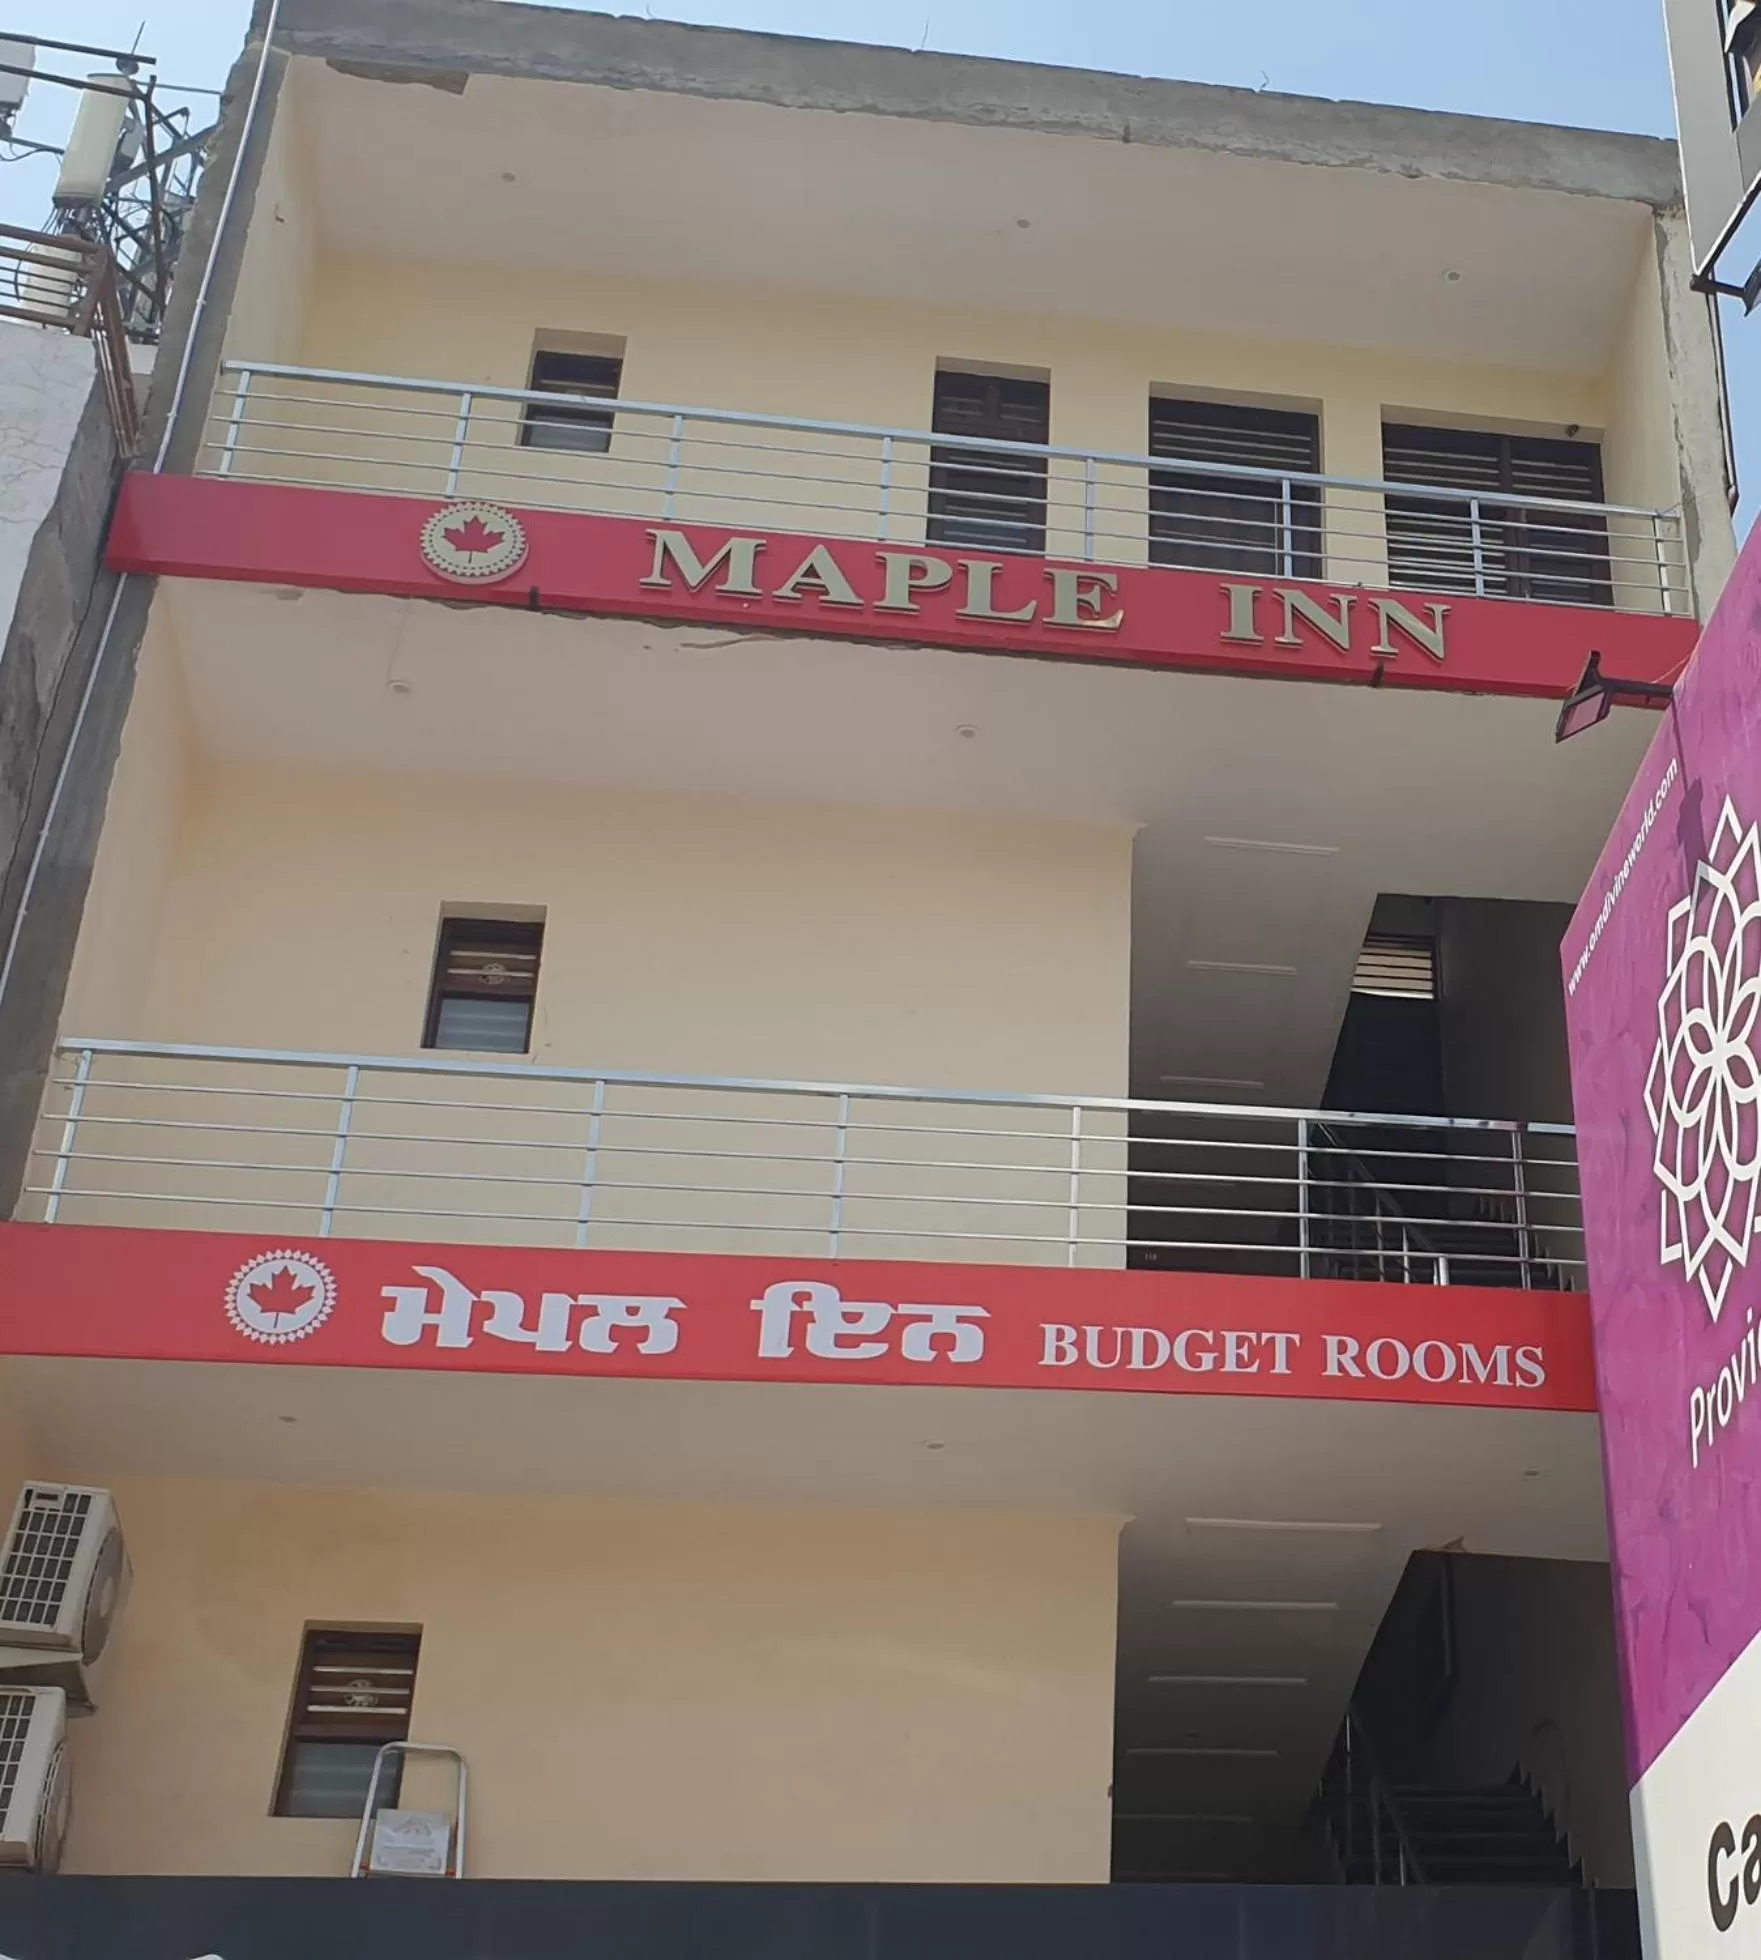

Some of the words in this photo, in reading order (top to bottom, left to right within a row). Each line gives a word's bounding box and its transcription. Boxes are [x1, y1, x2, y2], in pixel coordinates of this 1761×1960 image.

[639, 527, 1125, 633] MAPLE
[1219, 582, 1452, 663] INN
[1567, 758, 1679, 997] www.omdivineworld.com
[380, 1265, 688, 1355] ਮੇਪਲ
[750, 1280, 992, 1363] ਇਨ
[1039, 1322, 1301, 1375] BUDGET
[1322, 1333, 1547, 1389] ROOMS
[1690, 1306, 1761, 1469] Provi
